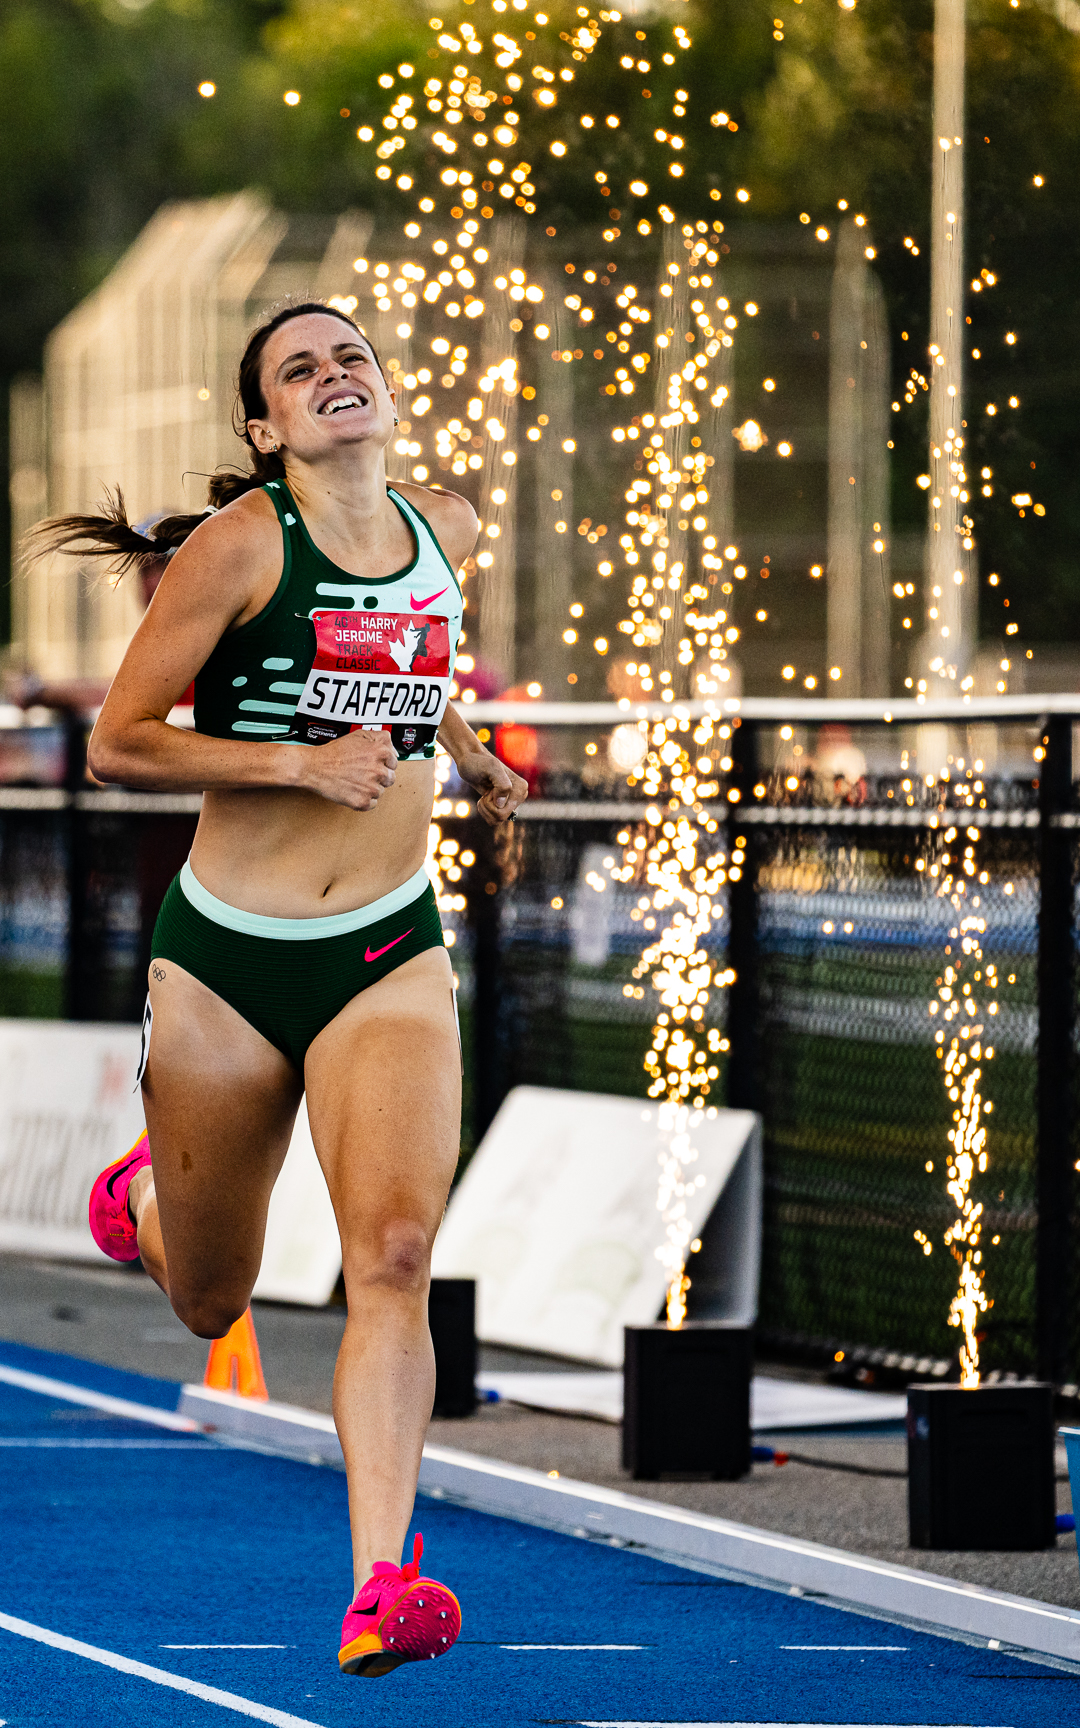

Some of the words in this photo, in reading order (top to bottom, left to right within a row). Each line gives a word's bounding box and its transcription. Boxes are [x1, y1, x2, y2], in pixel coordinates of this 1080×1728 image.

[361, 616, 398, 631] HARRY
[335, 629, 383, 644] JEROME
[335, 643, 374, 657] TRACK
[335, 657, 382, 671] CLASSIC
[306, 676, 443, 718] STAFFORD
